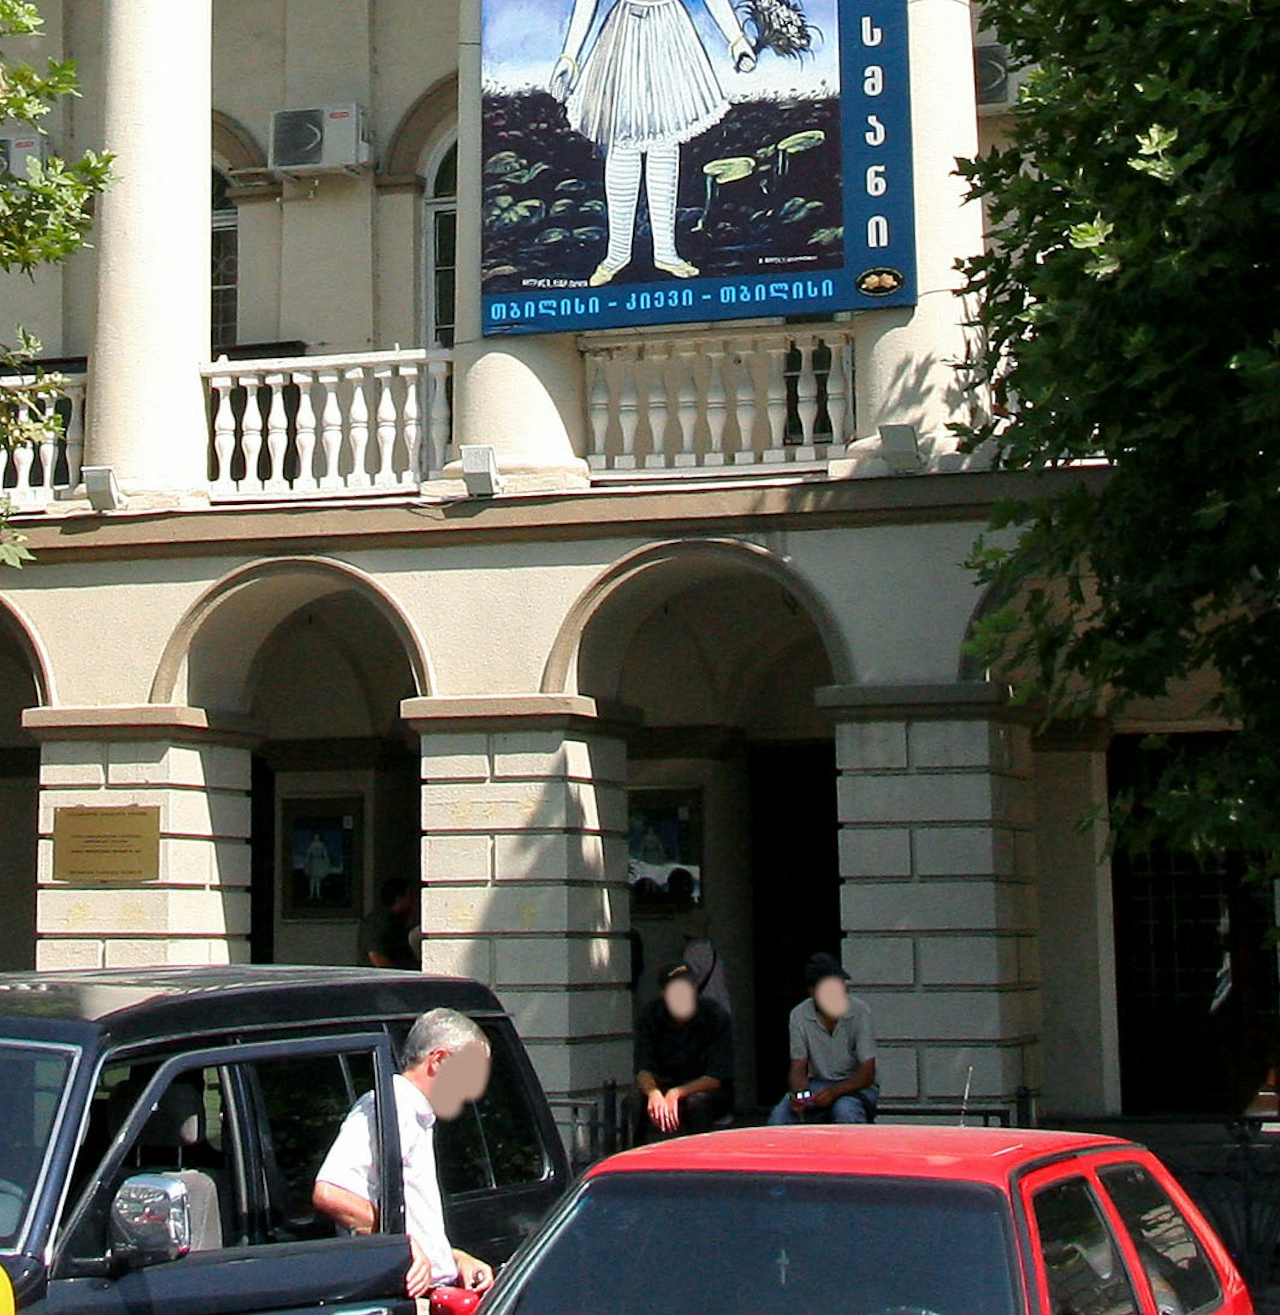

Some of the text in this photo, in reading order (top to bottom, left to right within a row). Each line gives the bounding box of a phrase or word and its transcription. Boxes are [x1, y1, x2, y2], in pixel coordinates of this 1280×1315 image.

[490, 296, 600, 320] თბილისი
[625, 288, 693, 311] კიევი
[720, 279, 833, 304] თბილისი
